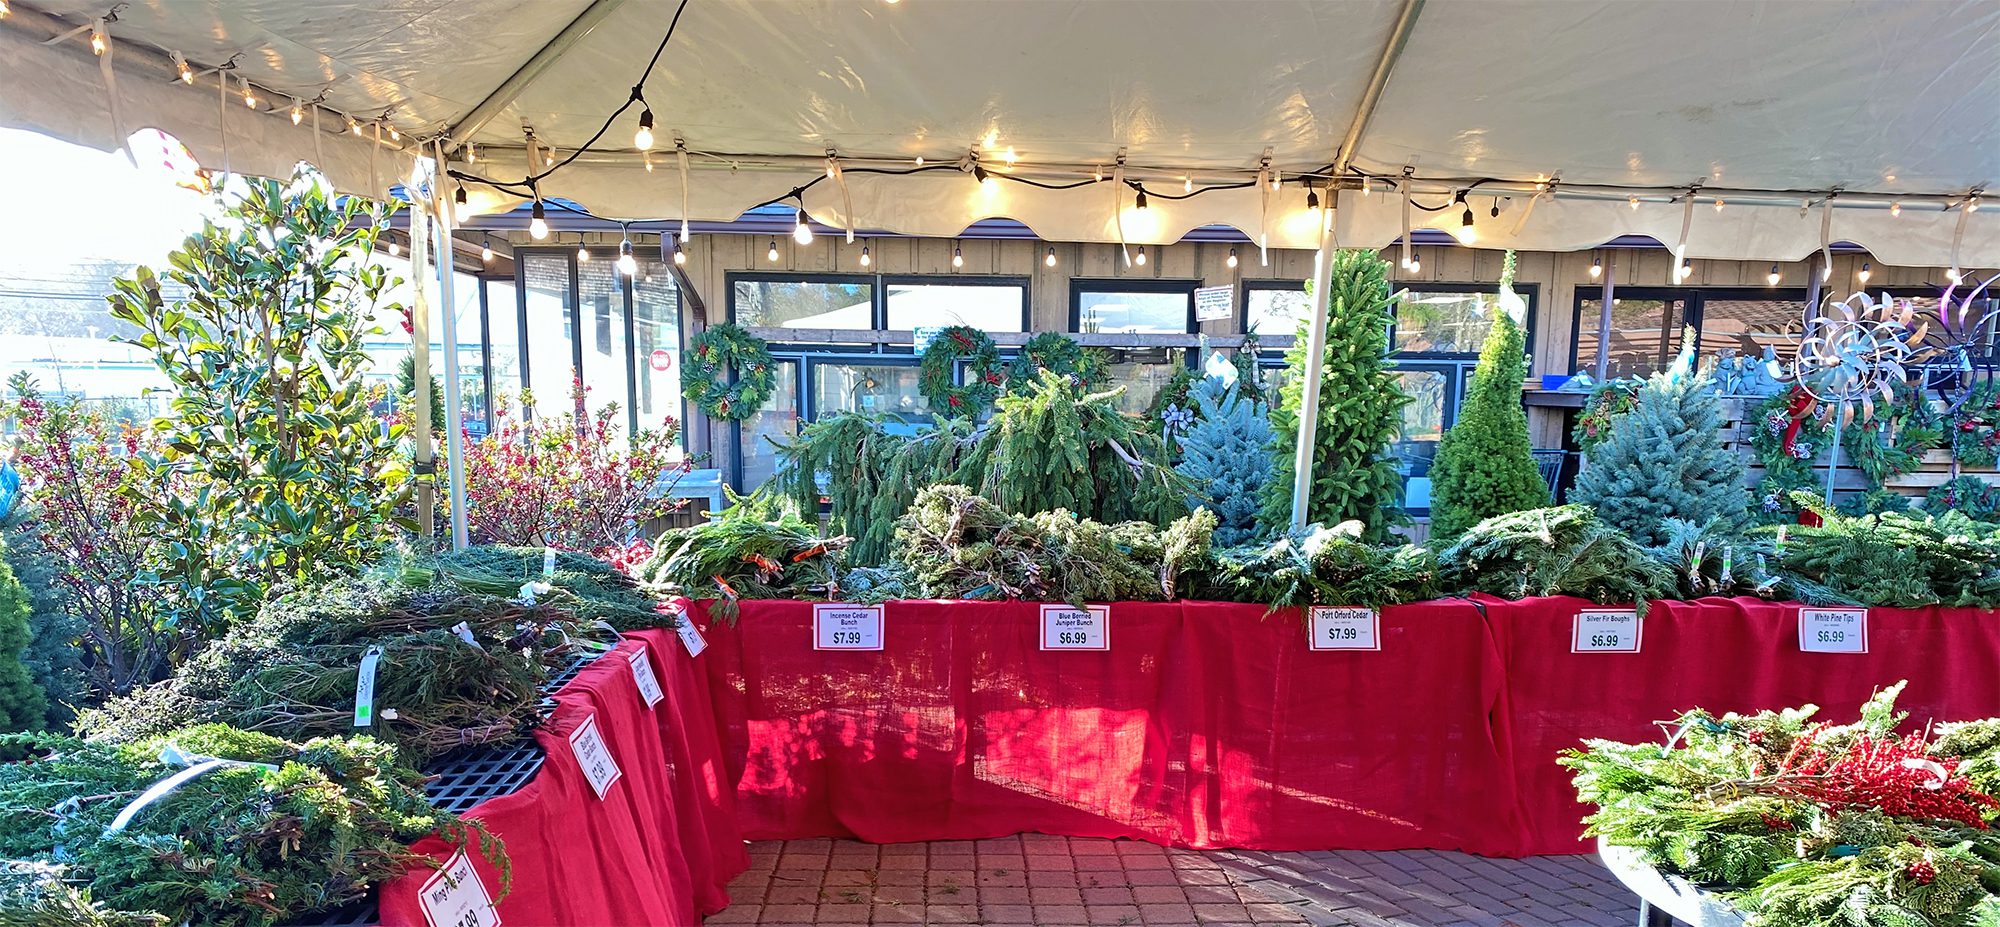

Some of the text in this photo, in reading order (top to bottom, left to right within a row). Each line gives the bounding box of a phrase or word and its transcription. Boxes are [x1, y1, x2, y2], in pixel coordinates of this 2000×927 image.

[1058, 612, 1071, 620] Blue
[1322, 611, 1368, 619] Port Orford Cedar
[1610, 615, 1630, 624] Boughs
[1814, 613, 1854, 624] White Pine Tips
[833, 632, 861, 644] $7.99
[1059, 632, 1087, 645] $6.99
[1329, 628, 1357, 640] $7.99
[1817, 630, 1845, 643] $6.99
[1591, 635, 1619, 647] $6.99
[431, 889, 448, 906] Ming
